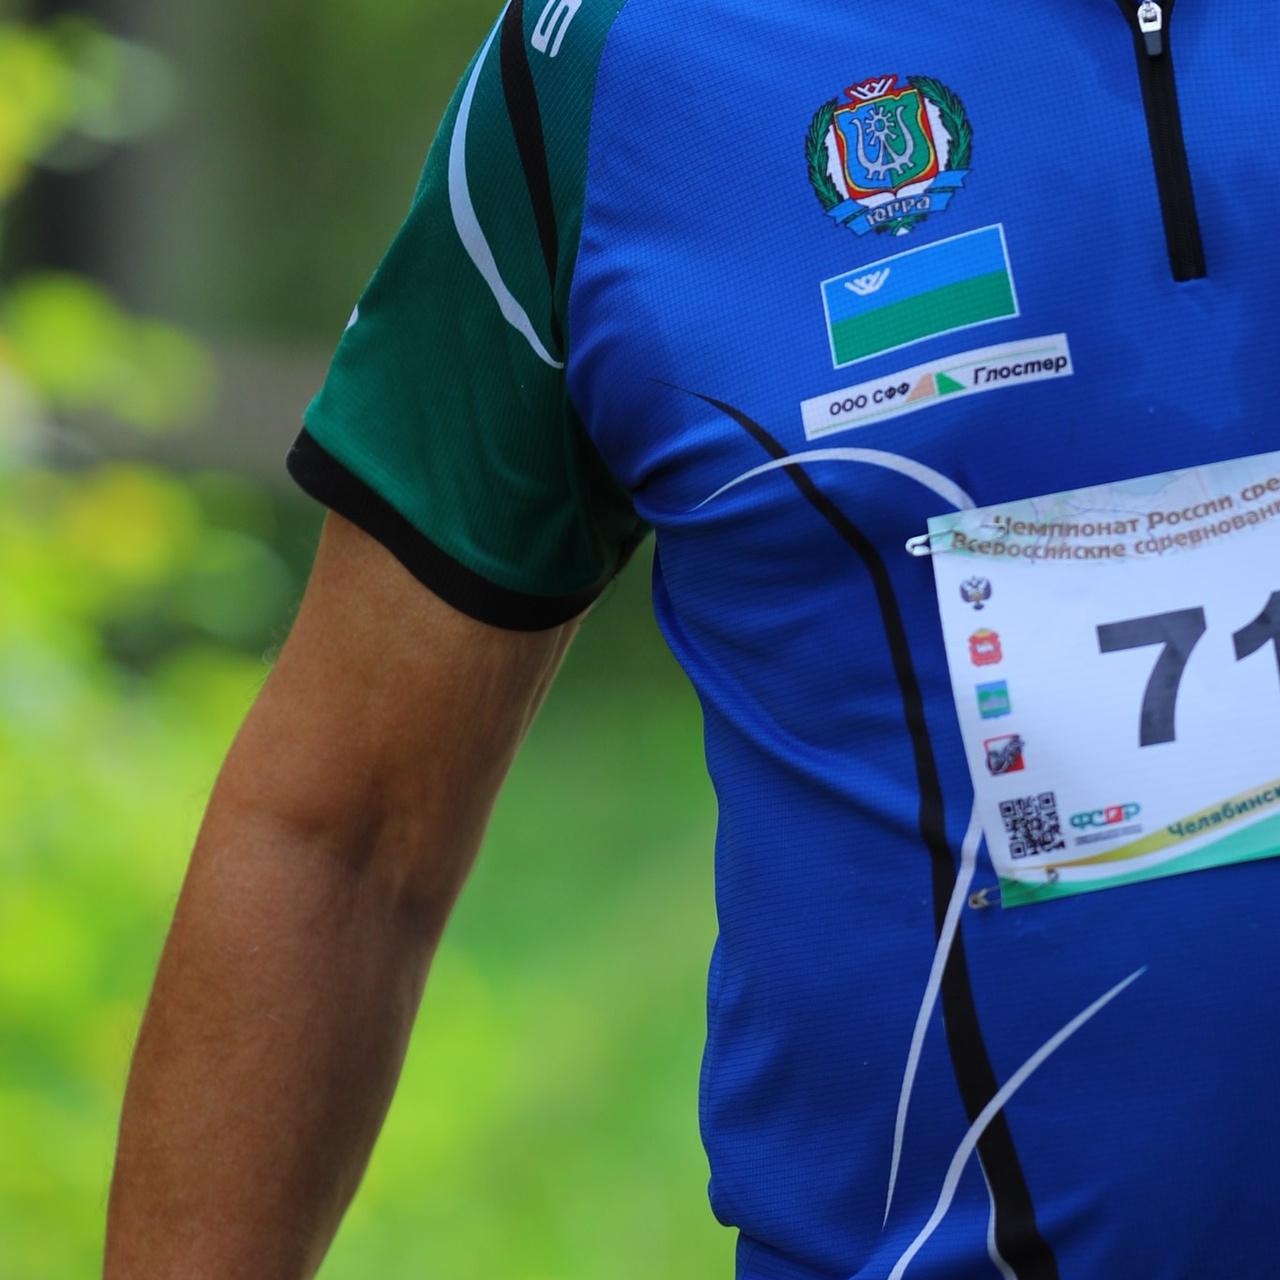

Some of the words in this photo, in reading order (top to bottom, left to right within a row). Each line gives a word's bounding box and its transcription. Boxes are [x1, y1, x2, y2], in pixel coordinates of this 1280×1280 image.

[829, 394, 867, 416] ООО
[972, 355, 1068, 385] Глостер
[1149, 495, 1233, 530] России
[951, 530, 1127, 560] Всероссийские
